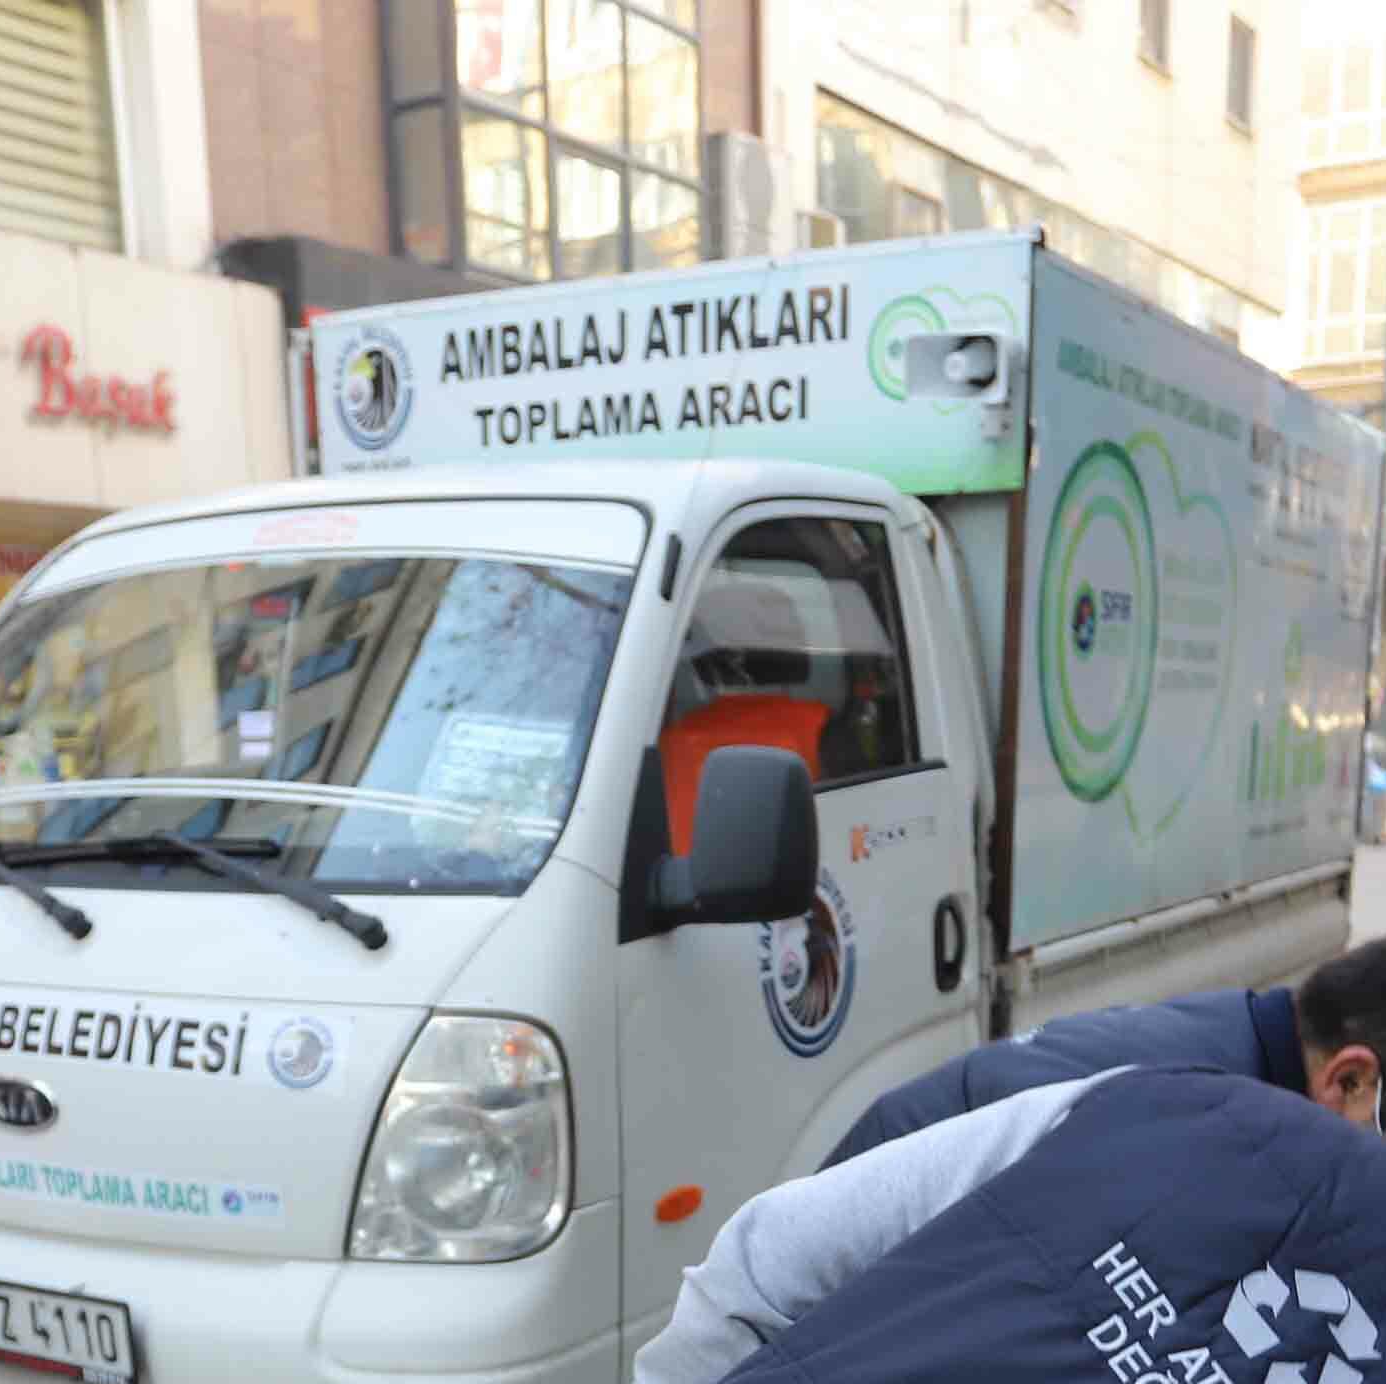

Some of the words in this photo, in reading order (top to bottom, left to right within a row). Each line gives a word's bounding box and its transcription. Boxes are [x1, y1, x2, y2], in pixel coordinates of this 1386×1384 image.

[440, 308, 628, 383] AMBALAJ
[643, 284, 850, 361] ATIKLARI
[474, 392, 663, 448] TOPLAMA
[677, 376, 809, 430] ARACI
[40, 1165, 137, 1208] TOPLAMA
[142, 1180, 210, 1216] ARACI
[1092, 1241, 1178, 1340] HER
[28, 1299, 118, 1363] 4110
